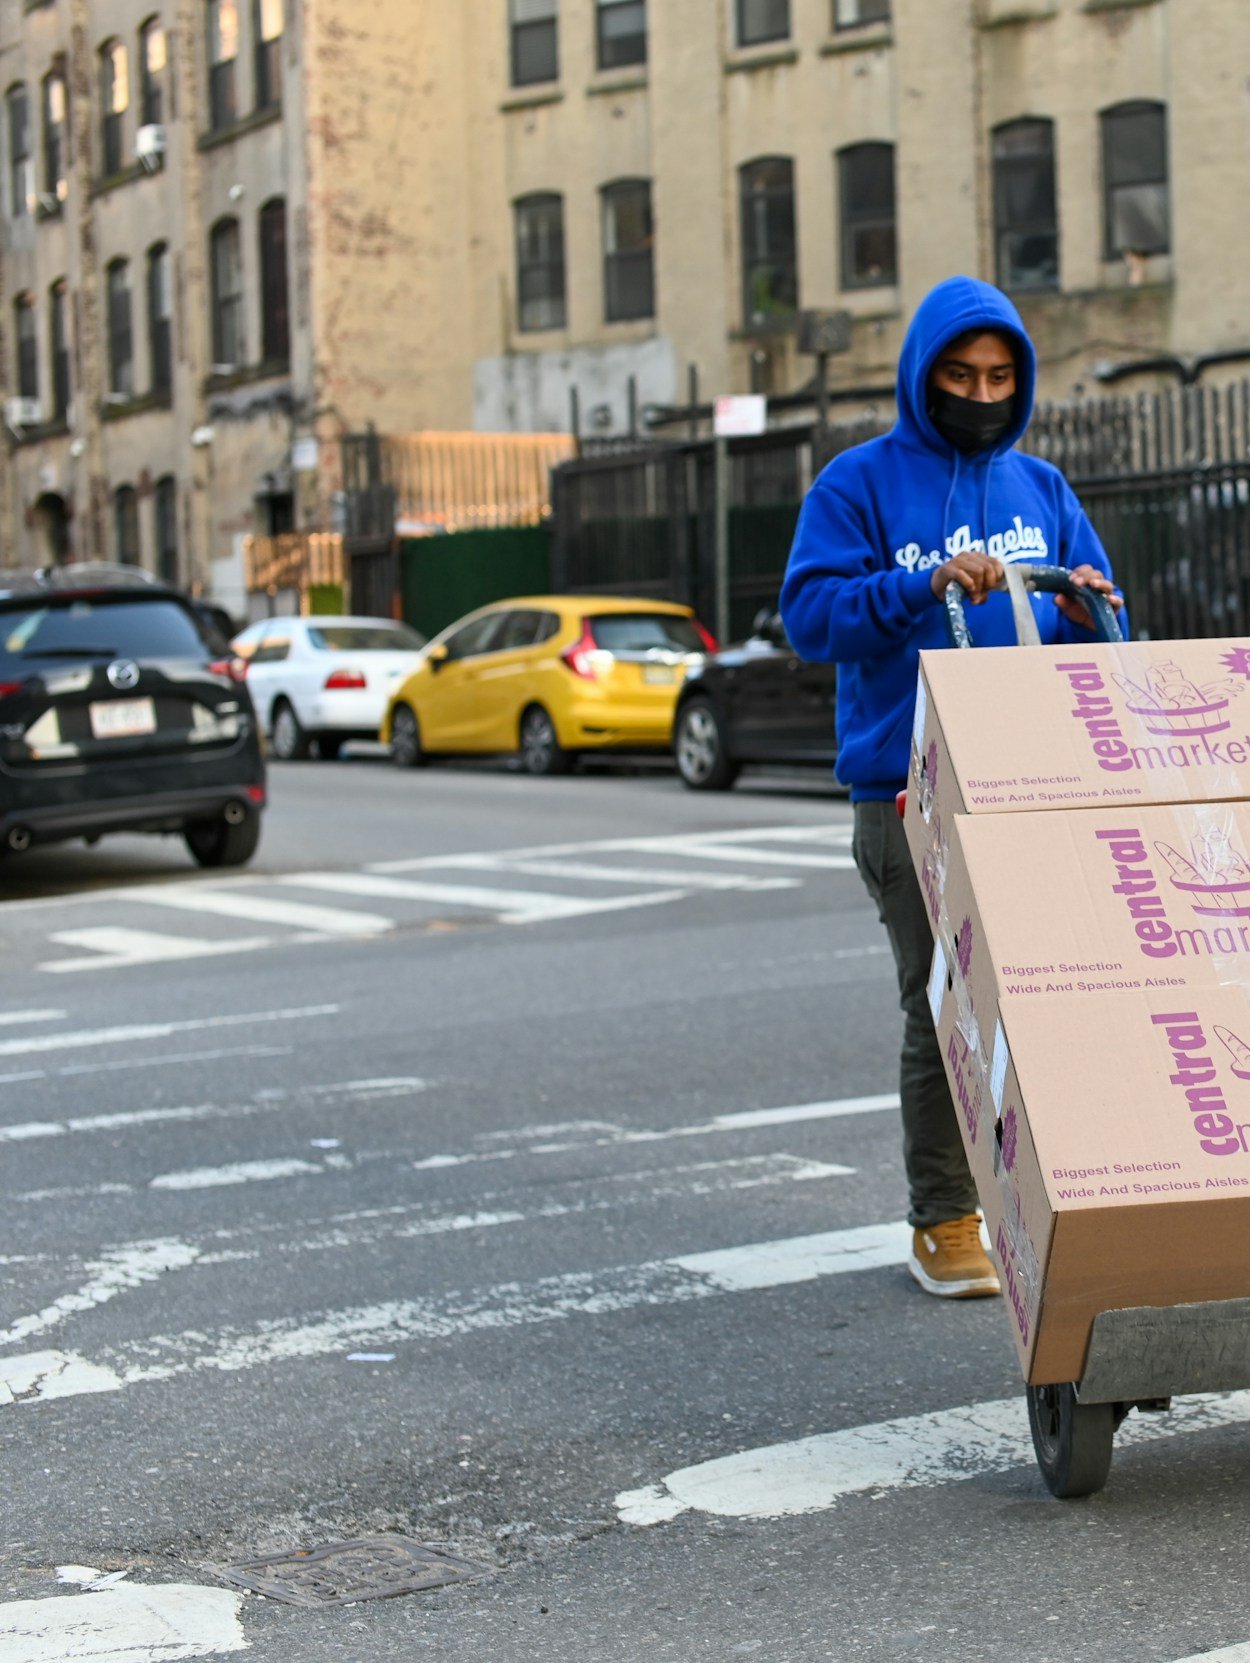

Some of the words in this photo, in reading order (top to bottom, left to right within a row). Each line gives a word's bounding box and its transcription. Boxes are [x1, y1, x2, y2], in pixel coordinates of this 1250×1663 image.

[945, 515, 1048, 565] Angeles
[1055, 662, 1134, 772] central
[967, 779, 1018, 789] Biggest
[1021, 775, 1082, 785] Selection
[971, 795, 1005, 804] Wide
[1008, 793, 1035, 802] And
[1038, 790, 1099, 801] Spacious
[1102, 787, 1142, 796] Aisles
[1095, 828, 1178, 958] central
[1002, 965, 1055, 976] Biggest
[1058, 961, 1123, 973] Selection
[1006, 984, 1041, 994] Wide
[1045, 982, 1073, 993] And
[1077, 979, 1141, 992] Spacious
[1144, 976, 1186, 987] Aisles
[1150, 1012, 1240, 1156] central
[1052, 1165, 1110, 1179] Biggest
[1113, 1161, 1181, 1174] Selection
[1057, 1187, 1095, 1199] Wide
[1099, 1184, 1129, 1196] And
[1133, 1180, 1201, 1194] Spacious
[1205, 1176, 1249, 1188] Aisles
